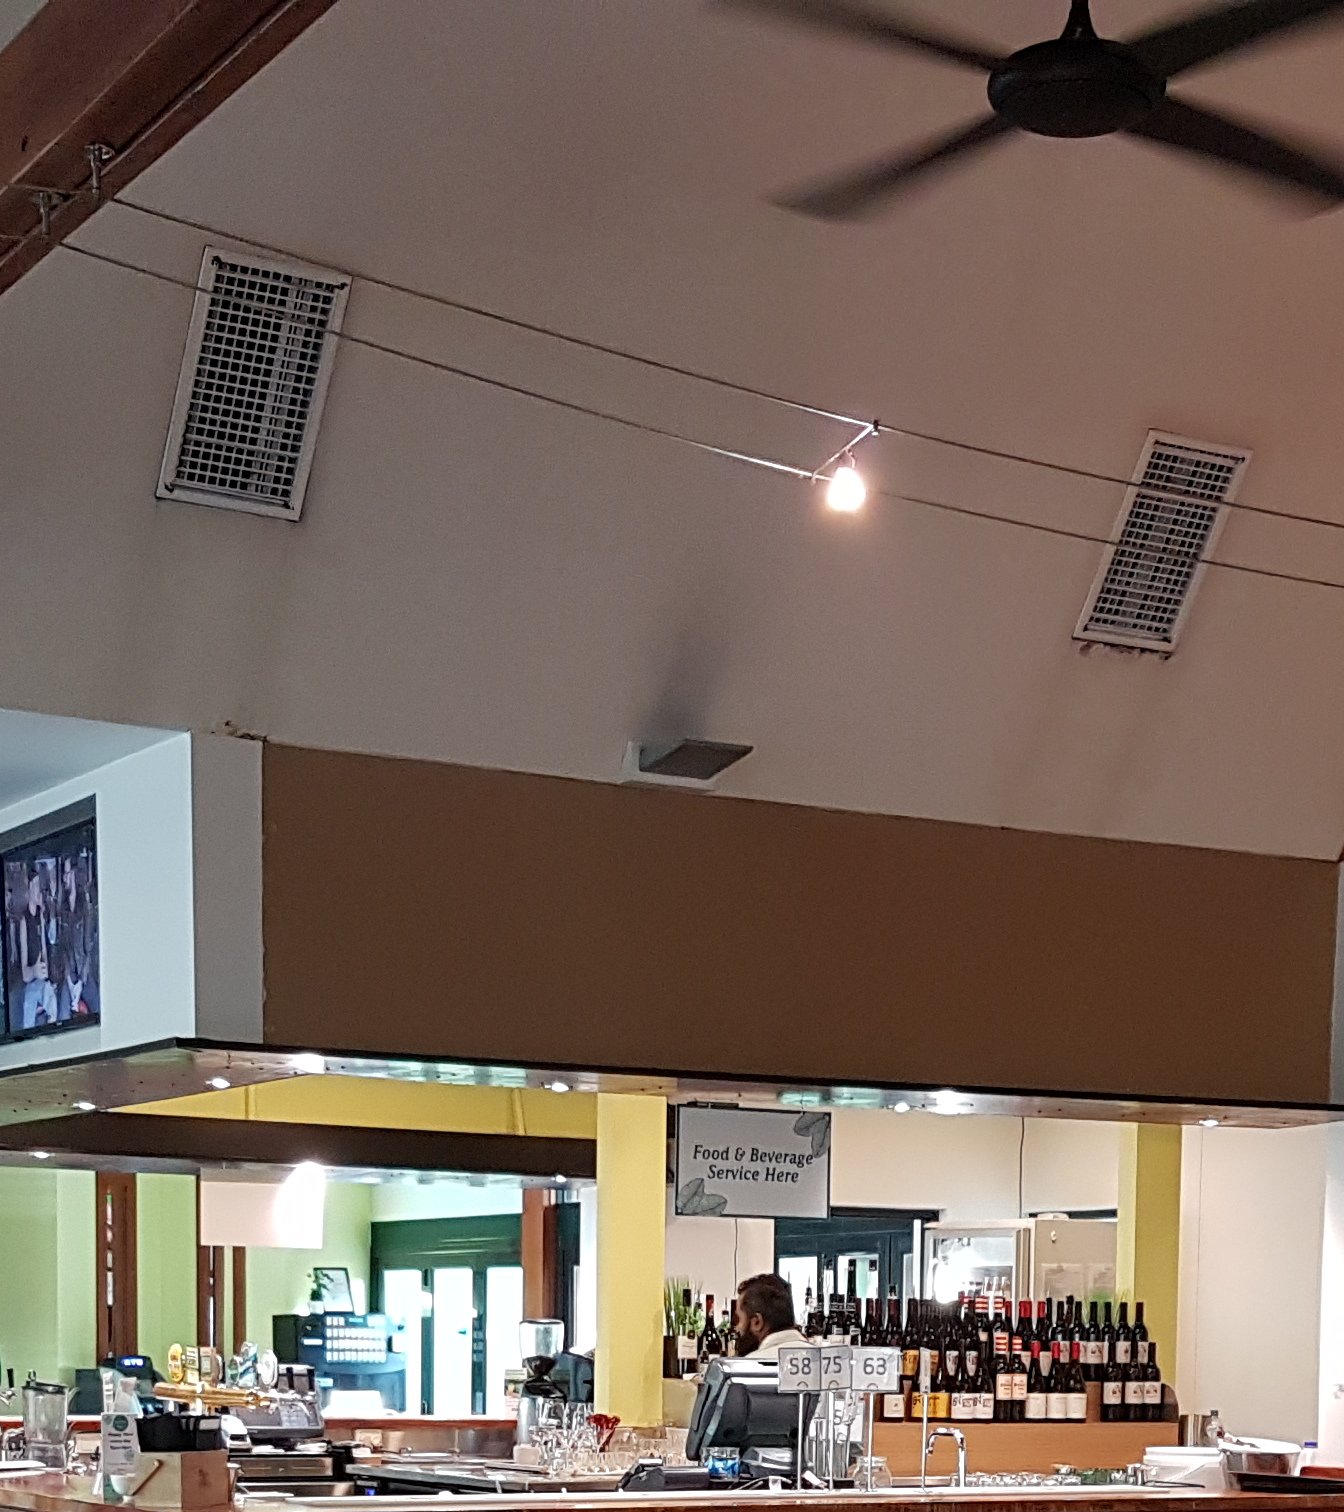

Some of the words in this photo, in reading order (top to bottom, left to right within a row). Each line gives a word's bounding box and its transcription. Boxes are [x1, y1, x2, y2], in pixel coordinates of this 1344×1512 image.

[693, 1144, 730, 1161] Food
[734, 1146, 746, 1162] &
[750, 1147, 814, 1168] Beverage
[707, 1164, 760, 1181] Service
[764, 1167, 800, 1183] Here
[789, 1357, 812, 1375] 58
[822, 1356, 842, 1375] 75
[863, 1357, 887, 1376] 63
